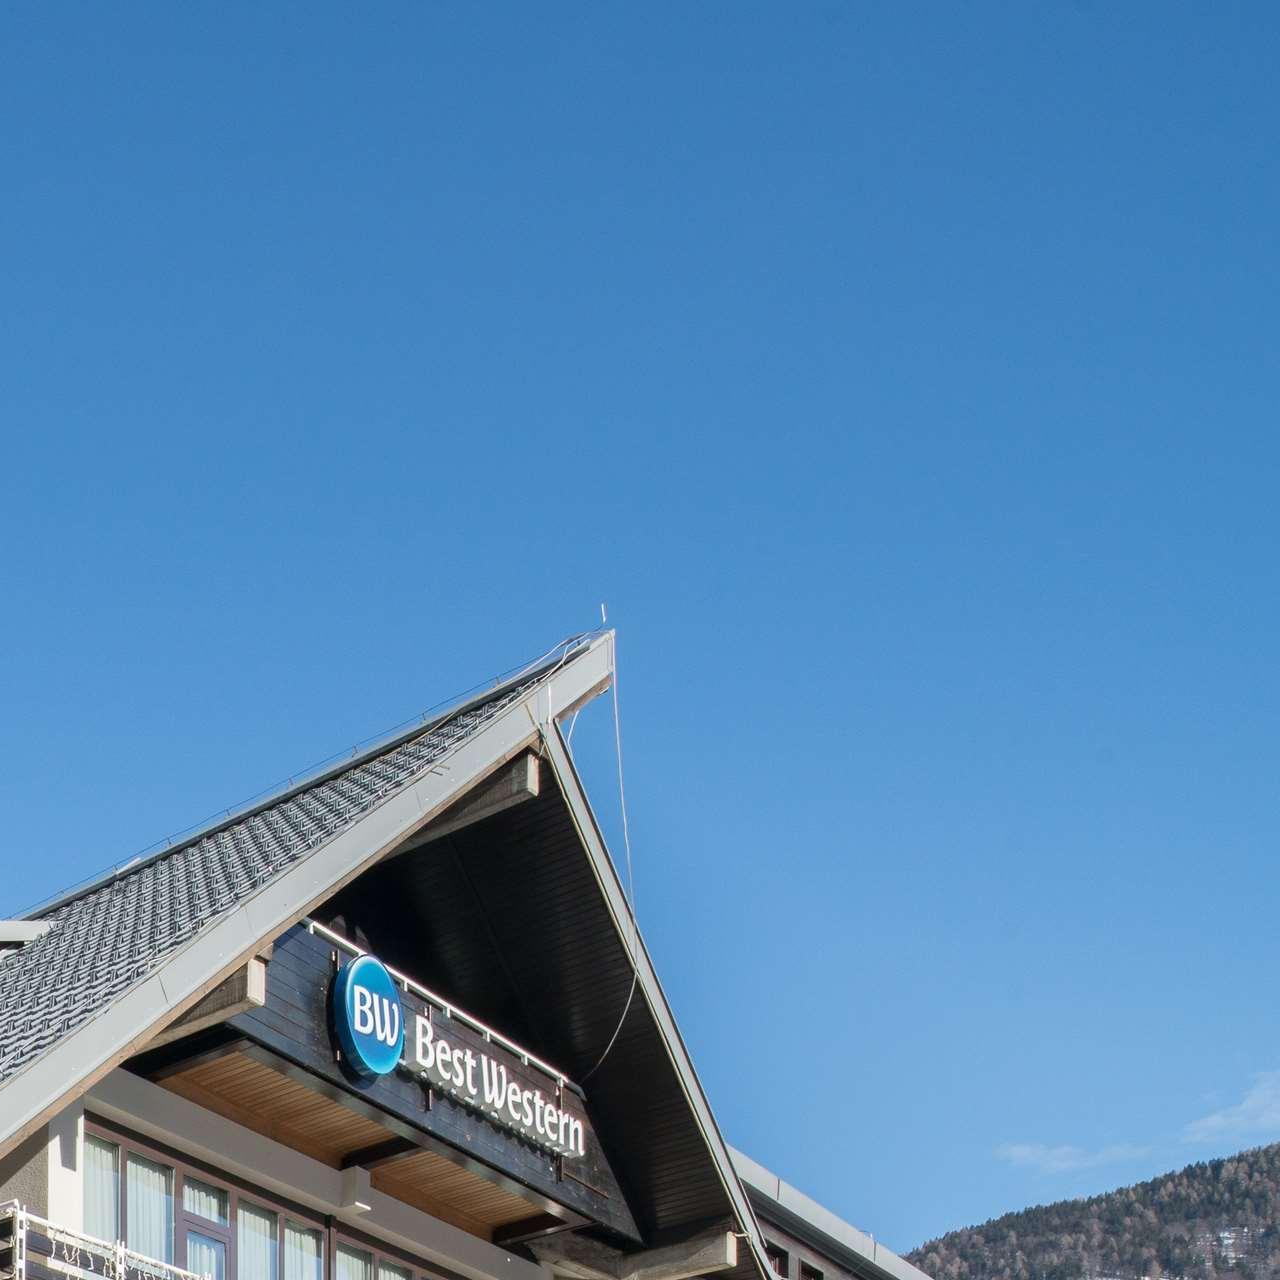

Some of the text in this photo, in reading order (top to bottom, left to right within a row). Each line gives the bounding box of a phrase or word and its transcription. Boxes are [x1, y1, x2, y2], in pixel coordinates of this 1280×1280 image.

[353, 984, 399, 1047] BW
[415, 1014, 585, 1157] Best Western
